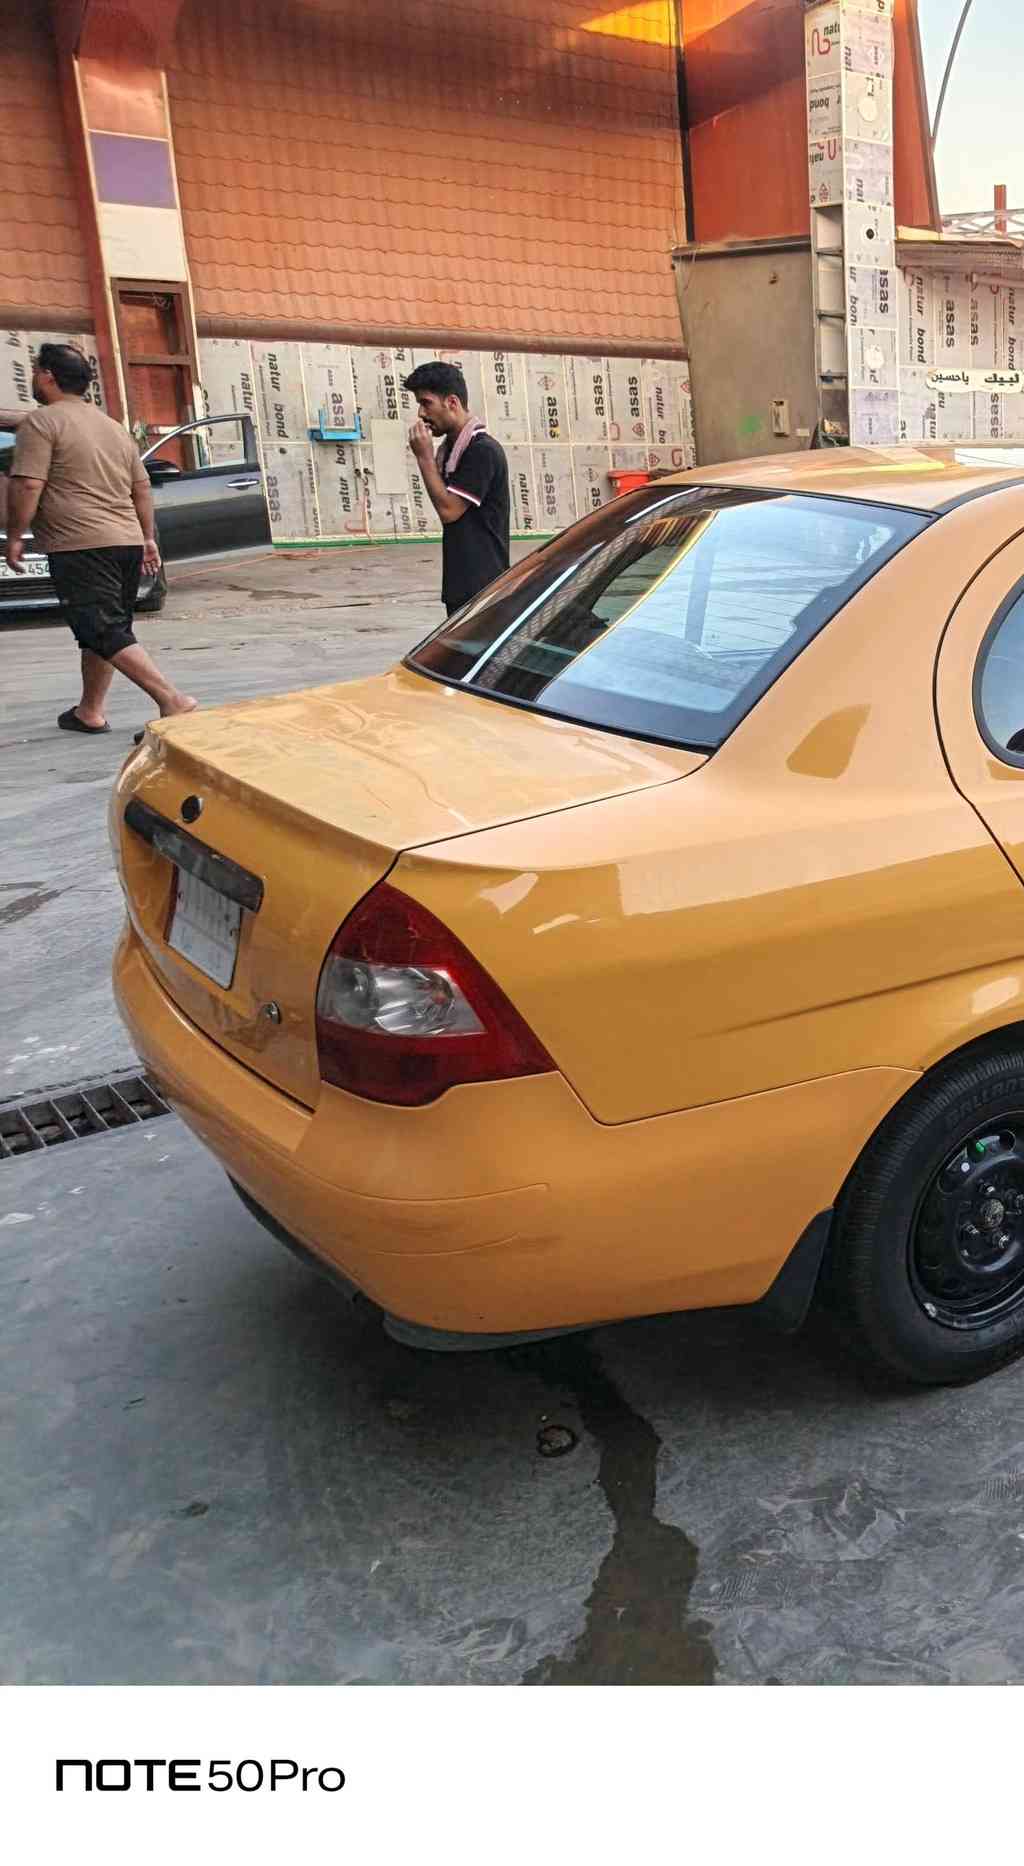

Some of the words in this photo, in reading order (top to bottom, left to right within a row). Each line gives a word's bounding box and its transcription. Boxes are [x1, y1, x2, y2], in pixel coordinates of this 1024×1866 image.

[849, 296, 859, 326] bon
[945, 299, 955, 348] asas
[970, 297, 979, 346] asas
[916, 328, 926, 364] bond
[1007, 337, 1018, 371] bond
[13, 361, 29, 402] natur
[239, 372, 253, 412] natur
[267, 353, 281, 392] natur
[493, 352, 507, 396] asas
[984, 373, 1020, 386] لبيك
[384, 374, 399, 420] asas
[592, 374, 605, 417] asas
[628, 376, 640, 418] asas
[655, 387, 665, 421] natur
[990, 393, 1000, 439] asas
[273, 403, 289, 439] bond
[547, 396, 560, 439] asas
[265, 475, 282, 523] asas
[339, 477, 352, 513] natur
[544, 473, 557, 516] asas
